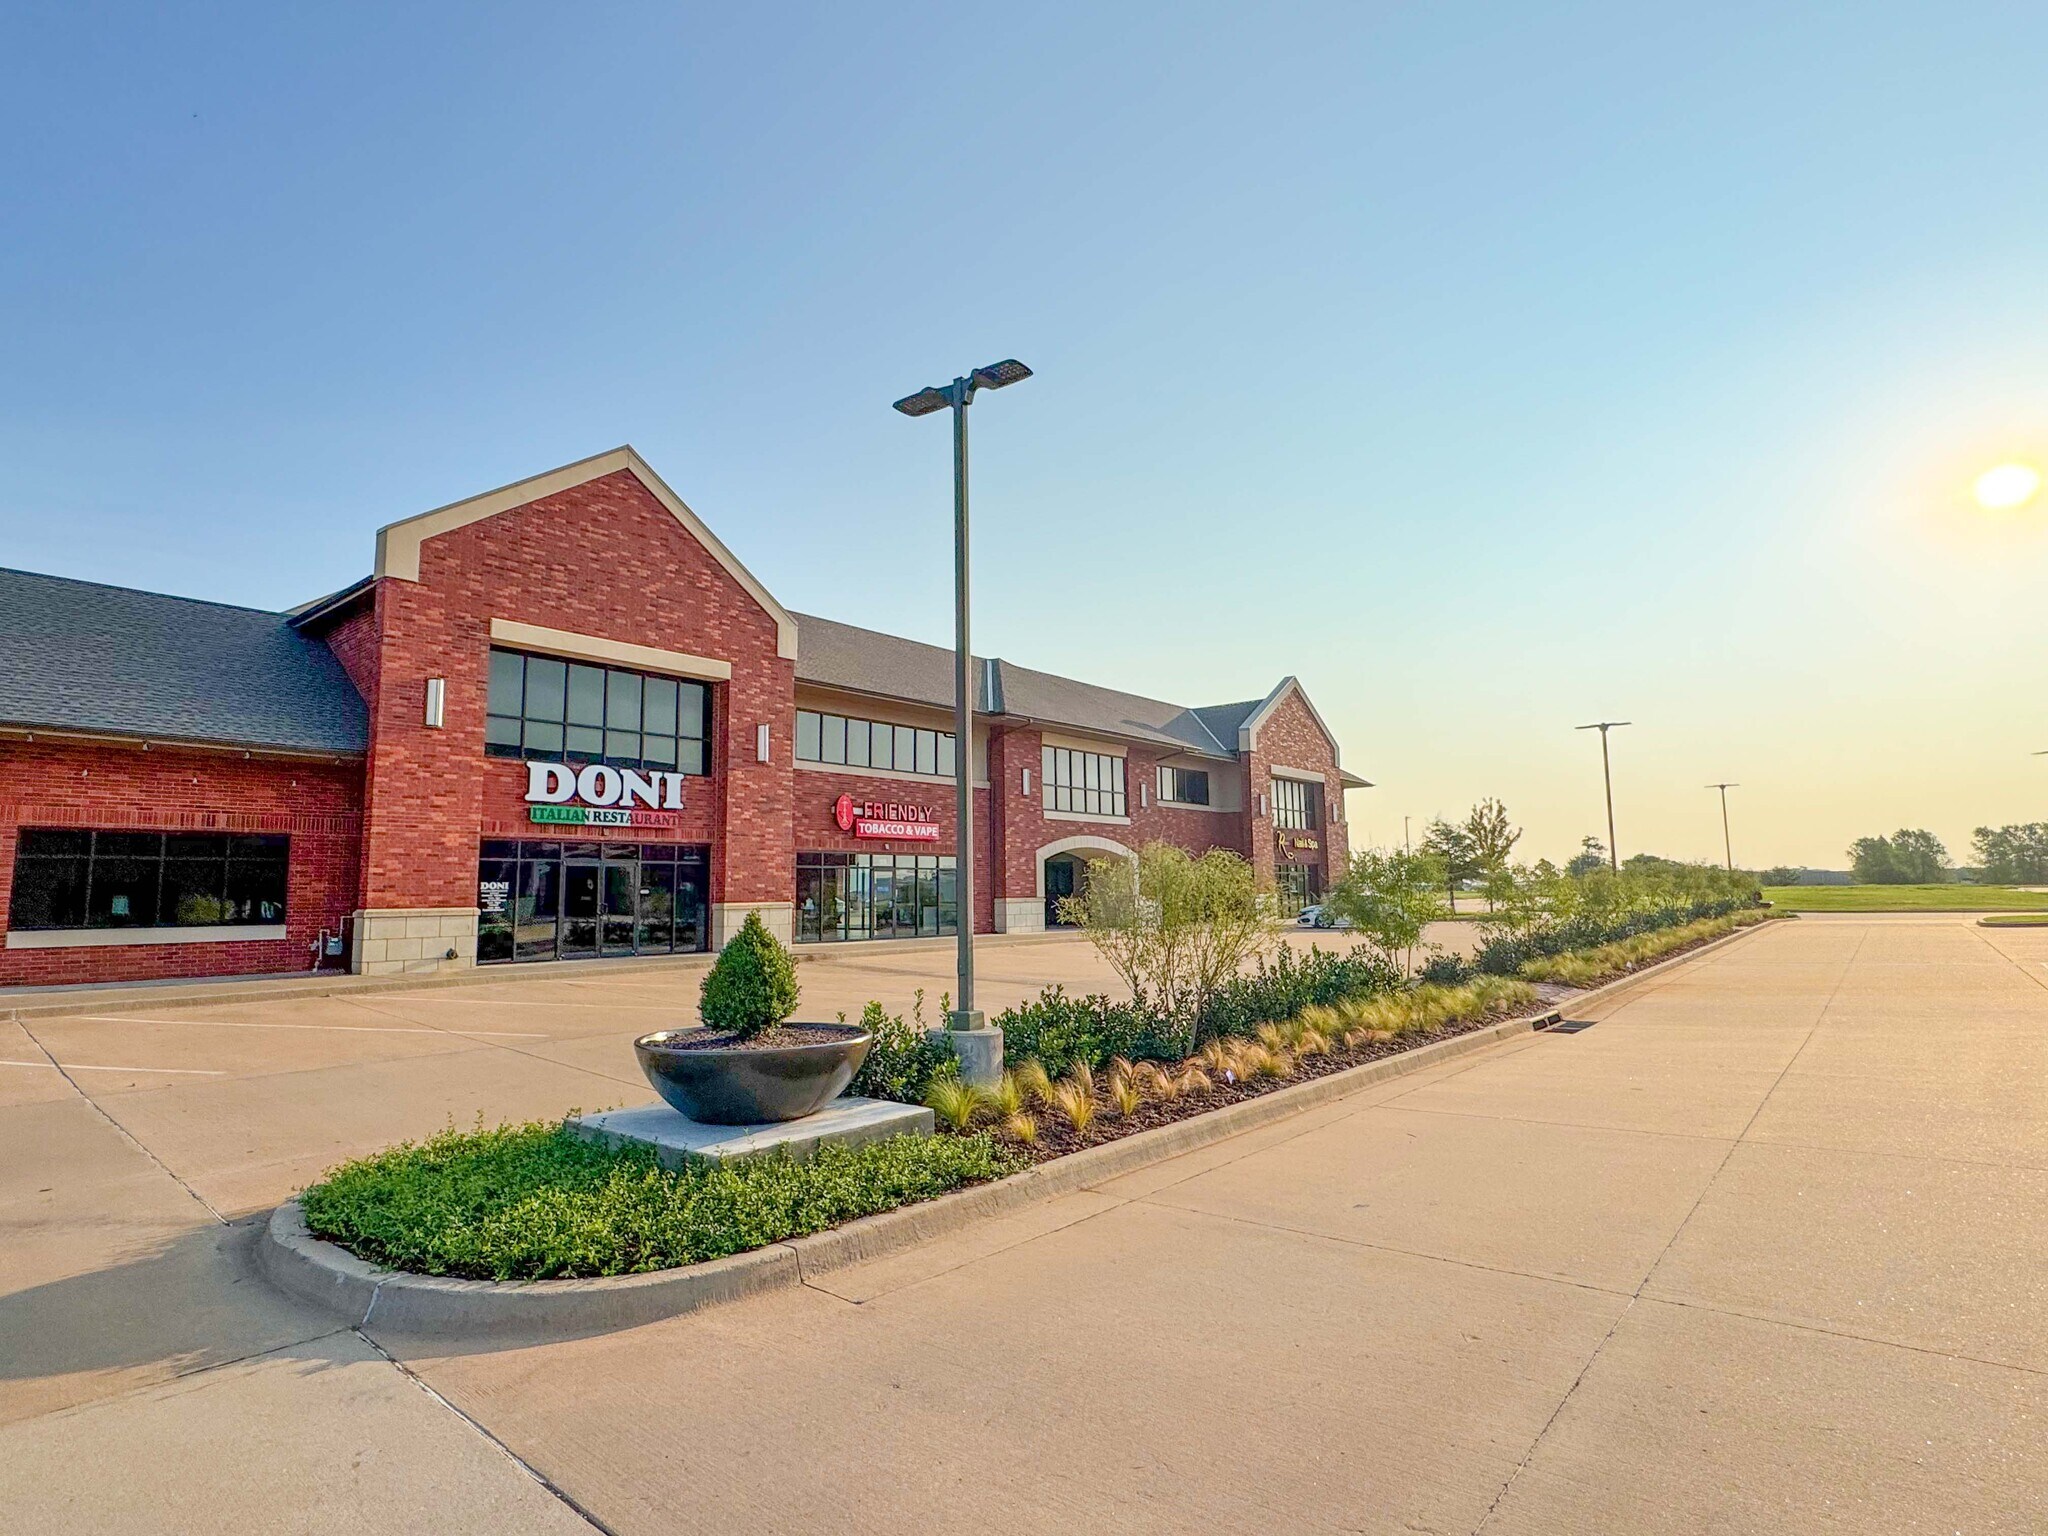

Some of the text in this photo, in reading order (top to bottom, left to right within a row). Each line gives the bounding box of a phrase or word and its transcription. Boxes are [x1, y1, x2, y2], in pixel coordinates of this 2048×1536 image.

[524, 761, 685, 810] DONI
[531, 806, 679, 827] ITALIAN RESTAURANT
[864, 802, 932, 822] FRIENDLY
[859, 823, 938, 836] TOBACCO & VAPE
[1308, 838, 1318, 850] Spa
